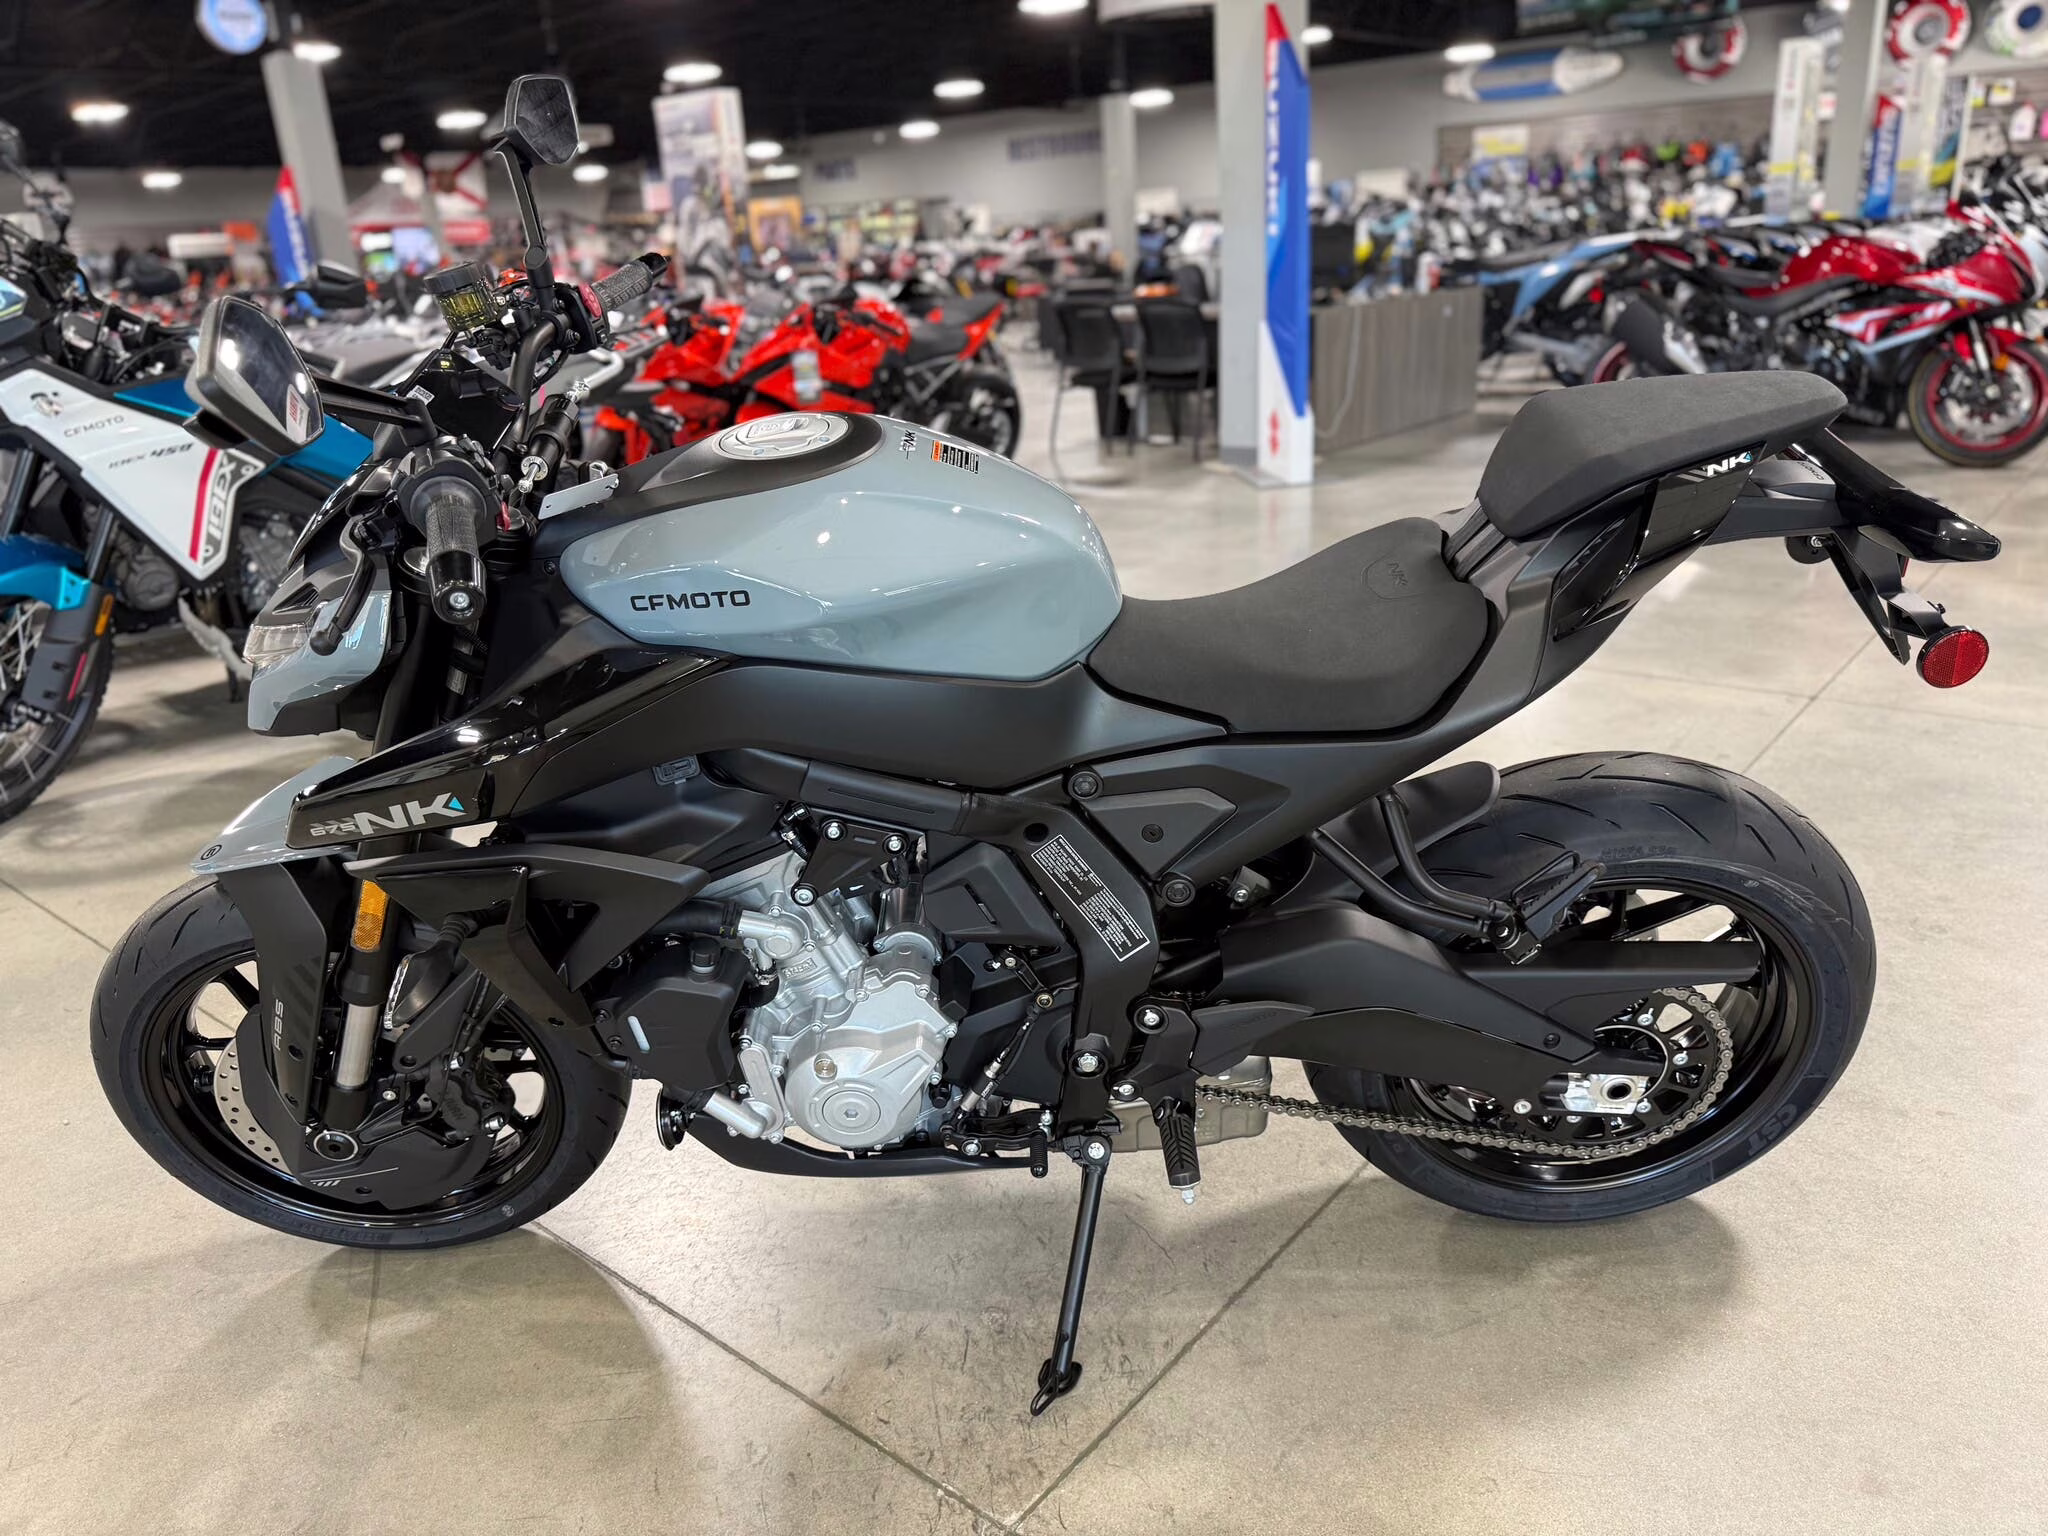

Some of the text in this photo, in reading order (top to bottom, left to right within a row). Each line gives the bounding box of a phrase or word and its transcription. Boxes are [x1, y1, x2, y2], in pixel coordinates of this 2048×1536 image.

[64, 415, 124, 437] CFMOTO
[1706, 451, 1751, 477] NK
[209, 455, 239, 541] IBEX
[630, 590, 751, 611] CFMOTO
[310, 792, 468, 837] 675 NK
[273, 998, 284, 1052] ABS
[1747, 1103, 1798, 1157] CST
